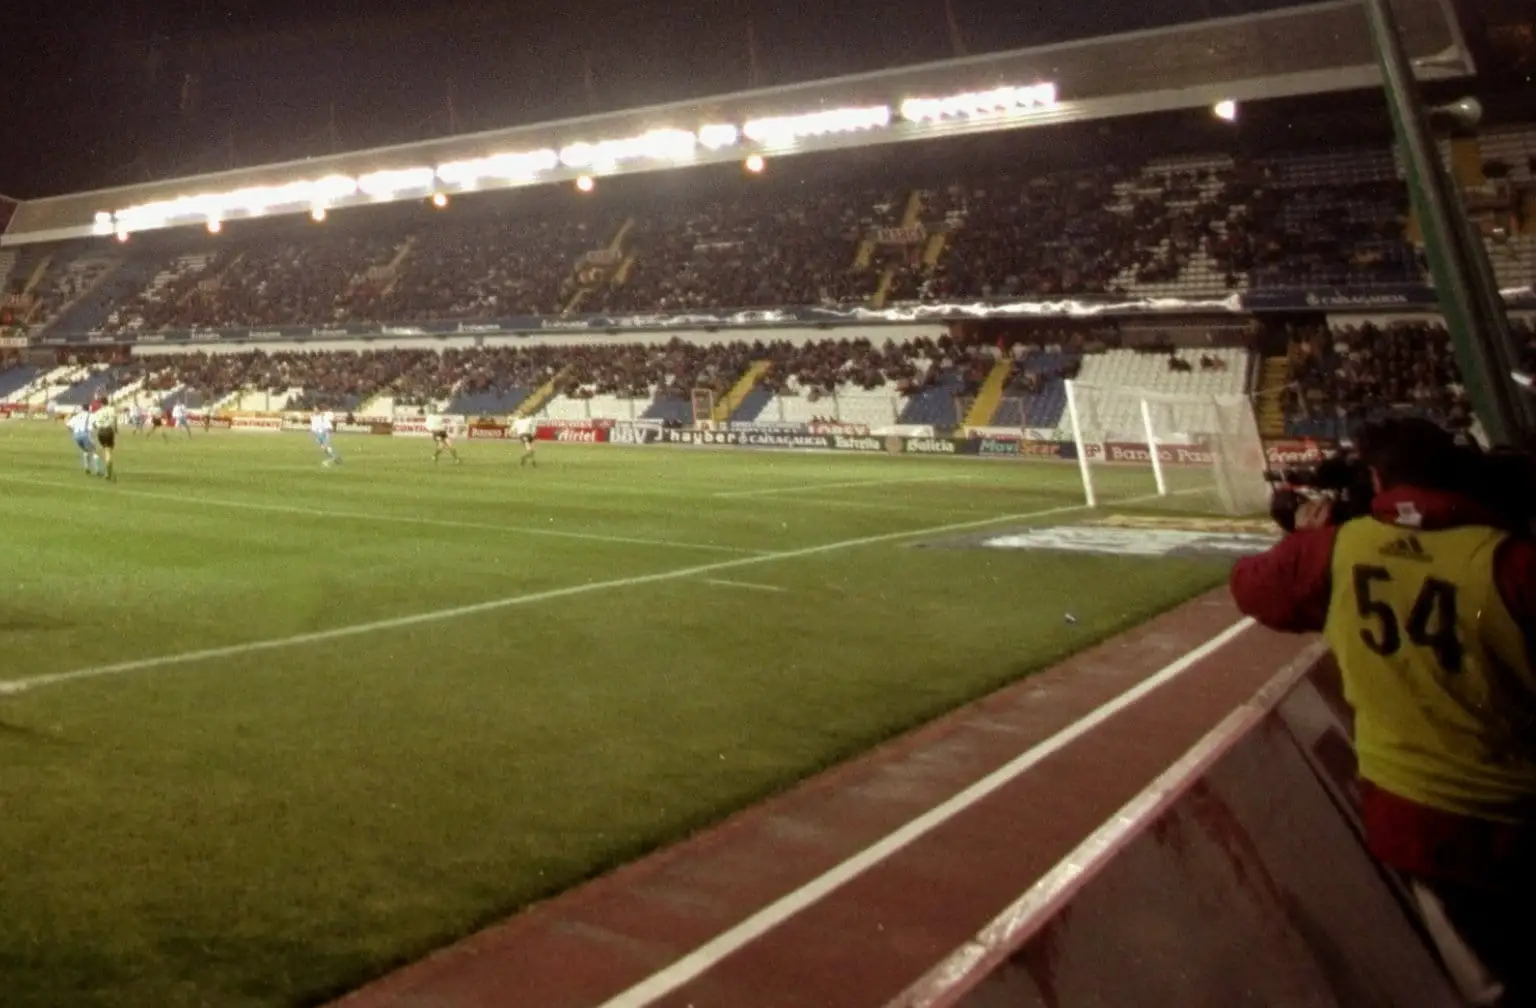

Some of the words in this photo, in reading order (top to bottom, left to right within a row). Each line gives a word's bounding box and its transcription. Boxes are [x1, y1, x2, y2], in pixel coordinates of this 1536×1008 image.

[558, 428, 597, 442] Airtel
[906, 439, 955, 453] Galicia
[1111, 447, 1173, 461] Bano
[1177, 448, 1218, 463] Past
[1352, 564, 1464, 673] 54
